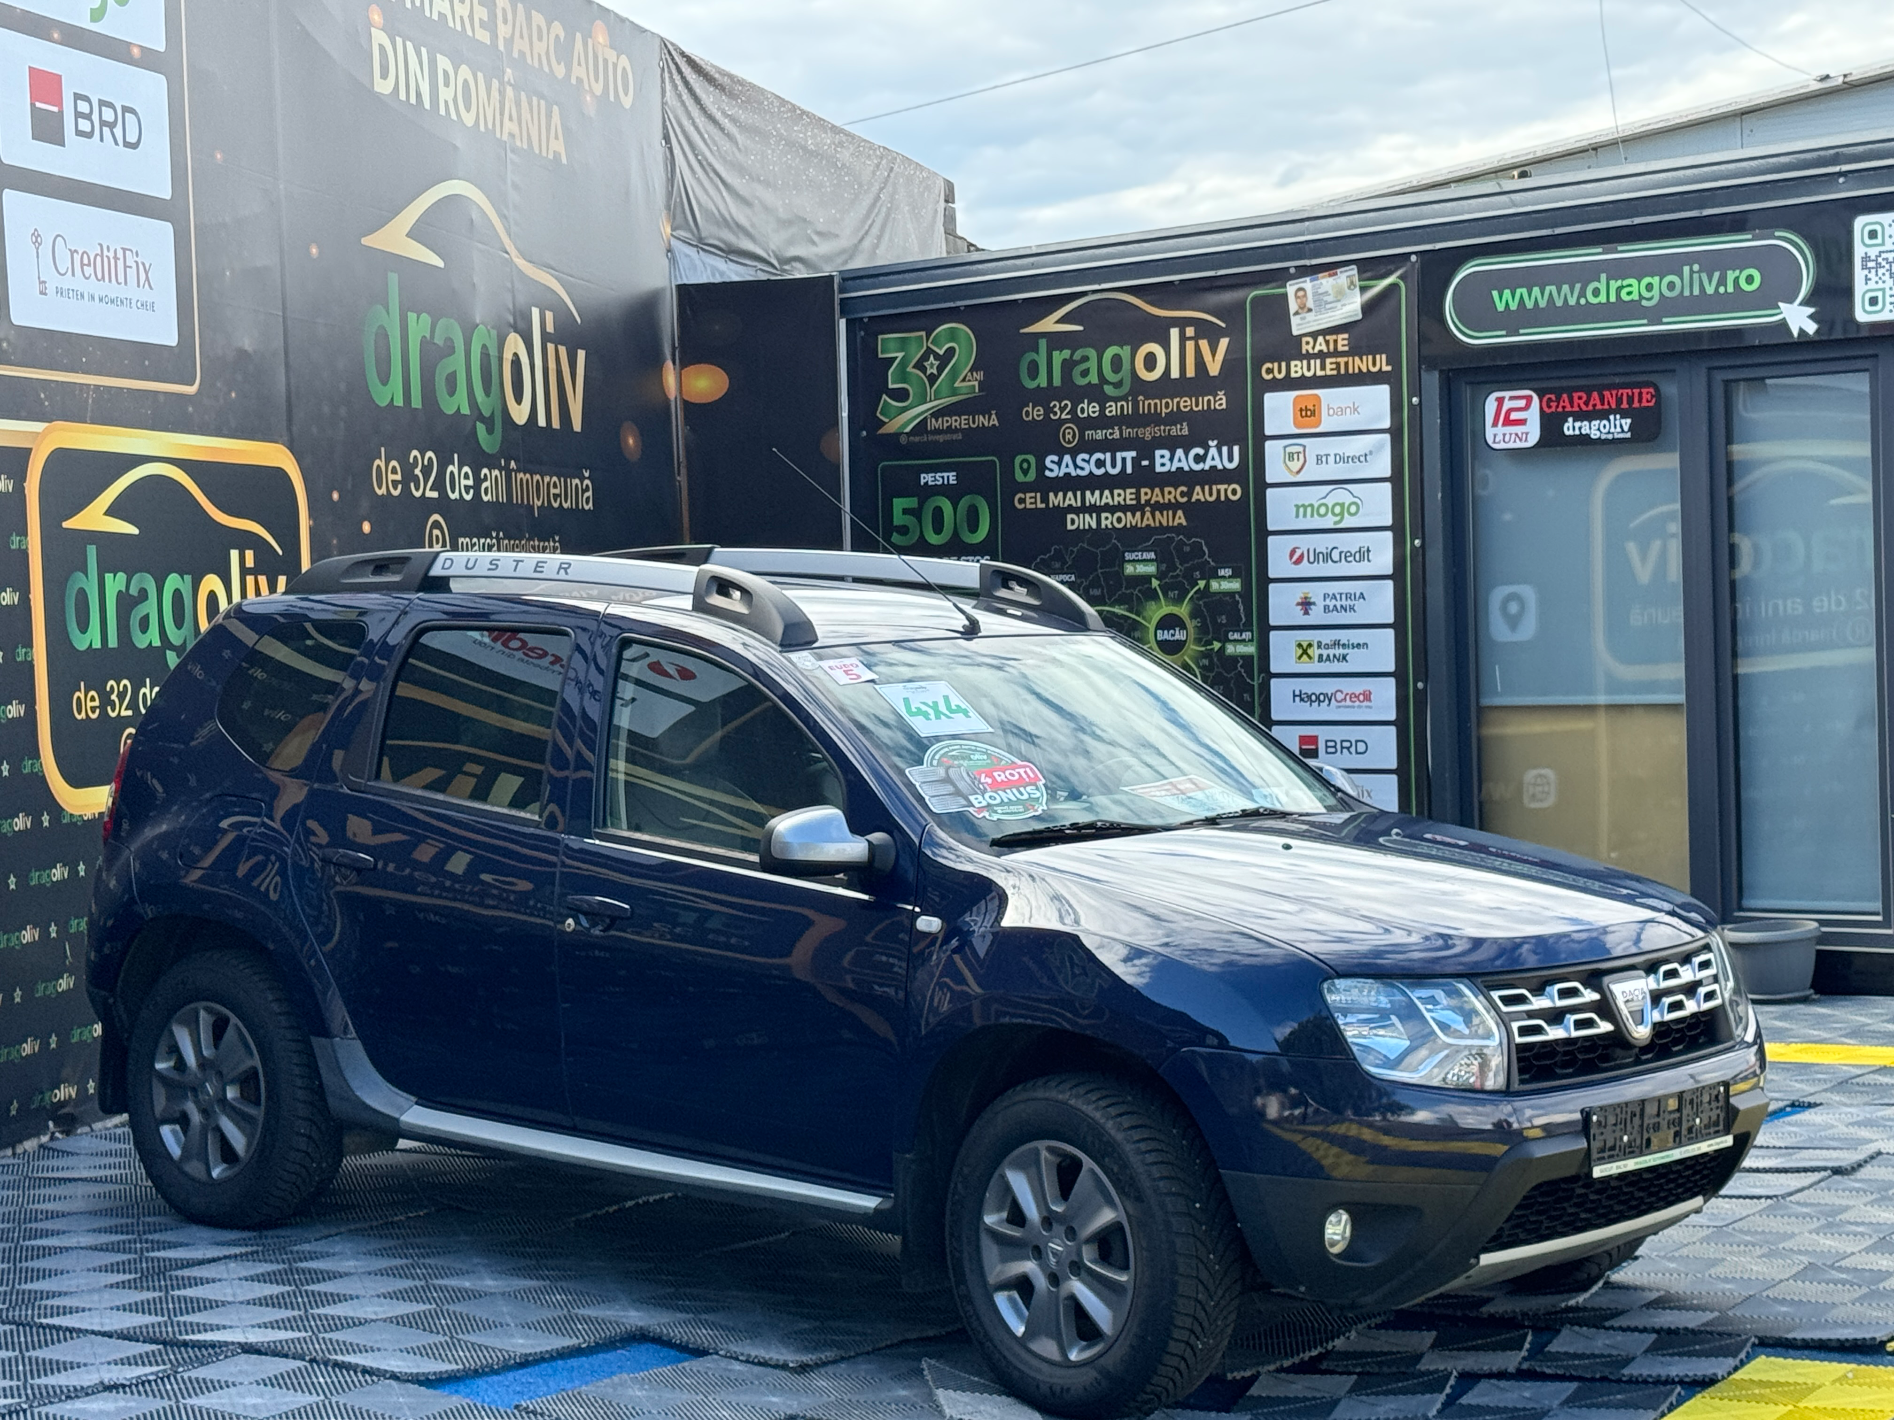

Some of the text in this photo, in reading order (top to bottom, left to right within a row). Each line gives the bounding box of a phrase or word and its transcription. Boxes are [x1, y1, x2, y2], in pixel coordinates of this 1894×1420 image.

[404, 0, 634, 110] ARE PARC AUTO
[370, 26, 567, 165] DIN ROMÂNIA
[73, 91, 143, 151] BRD
[51, 233, 154, 291] CreditFix
[1491, 263, 1762, 313] www.dragoliv.ro
[55, 286, 156, 313] PRIETEN IN MOMENTE CHEIE
[1301, 334, 1350, 354] RATE
[363, 271, 586, 454] dragoliv
[876, 322, 984, 423] 32 ANI
[1019, 326, 1230, 397] dragoliv
[1261, 354, 1392, 380] CU BULETINUL
[1022, 391, 1227, 421] de 32 de ani împreună
[1298, 402, 1360, 419] tbi bank
[1491, 387, 1656, 428] 12 GARANTIE
[927, 410, 999, 431] ÎMPREUNĂ
[1085, 426, 1120, 441] marcă
[1122, 422, 1188, 441] înregistrată
[1563, 414, 1632, 439] dragoliv
[1492, 431, 1529, 445] LUNI
[1044, 450, 1137, 478] SASCUT
[1154, 440, 1240, 473] BACĂU
[1287, 451, 1302, 463] BT
[1315, 454, 1331, 466] BT
[372, 447, 594, 517] de 32 de ani împreună
[920, 472, 957, 486] PESTE
[1014, 483, 1242, 509] CEL MAI MARE PARC AUTO
[890, 494, 990, 546] 500
[1066, 507, 1187, 531] DIN ROMÂNIA
[1294, 501, 1361, 526] mogo
[441, 557, 572, 576] DUSTER
[1124, 551, 1156, 560] SUCEAVA
[1307, 546, 1372, 565] UniCredit
[1323, 592, 1366, 602] PATRIA
[1323, 603, 1357, 614] BANK
[1157, 627, 1186, 641] BACĂU
[1316, 639, 1369, 650] Raiffeisen
[828, 663, 859, 671] EURO
[1317, 653, 1349, 664] BANK
[843, 669, 862, 681] 5
[73, 681, 100, 720] de
[106, 679, 133, 718] 32
[1292, 689, 1373, 708] HappyCredit
[1324, 739, 1369, 755] BRD
[980, 773, 992, 784] 4
[968, 786, 1041, 808] BONUS
[28, 863, 69, 886] dragoliv
[35, 973, 75, 997] dragoliv
[1621, 988, 1646, 999] DACIA
